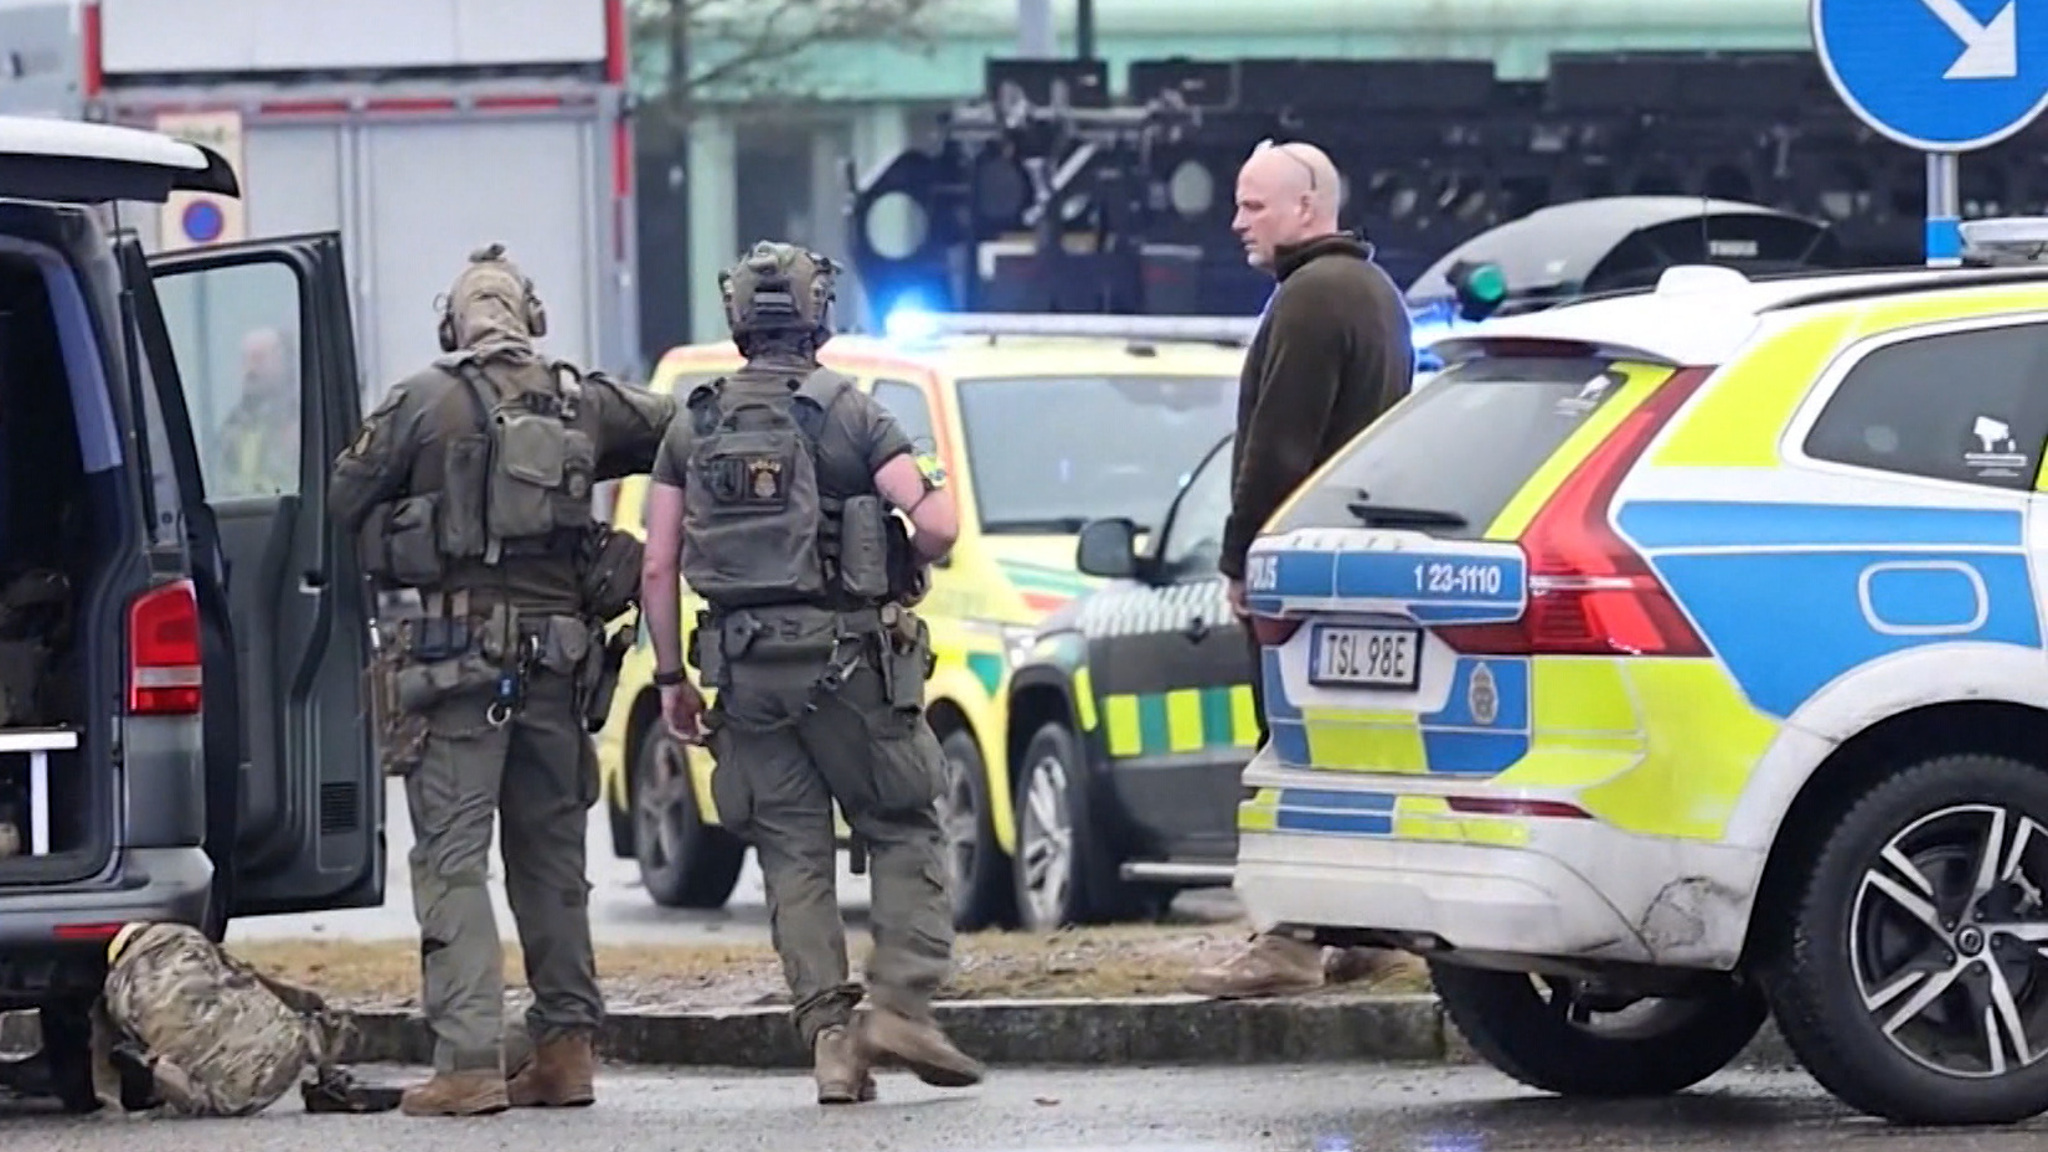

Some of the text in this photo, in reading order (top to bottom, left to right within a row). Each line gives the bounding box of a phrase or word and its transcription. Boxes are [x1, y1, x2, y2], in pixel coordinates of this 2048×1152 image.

[1414, 563, 1501, 593] 1 23-1110
[1328, 634, 1406, 677] TSL 98E
